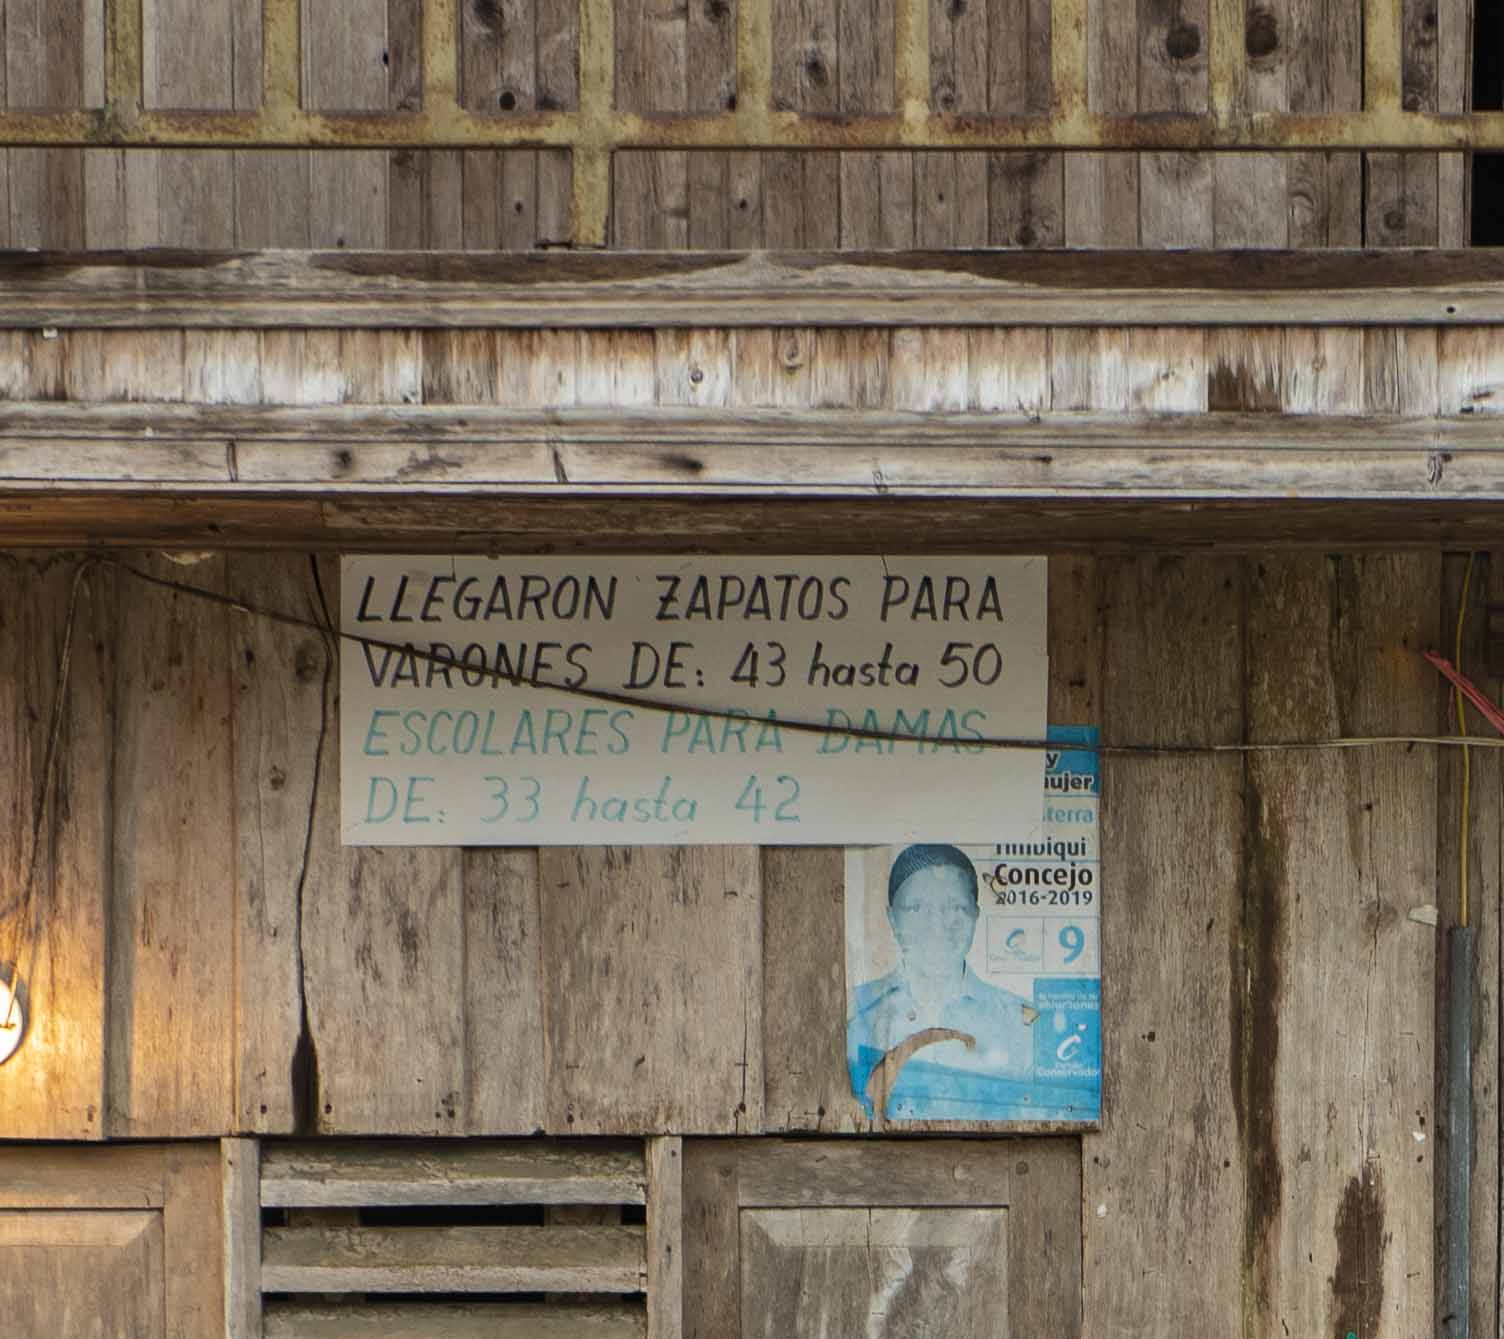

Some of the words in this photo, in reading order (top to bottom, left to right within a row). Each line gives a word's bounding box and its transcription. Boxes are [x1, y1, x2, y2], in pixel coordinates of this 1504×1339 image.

[356, 574, 618, 624] LLEGARON
[654, 574, 852, 623] ZAPATOS
[877, 574, 1004, 624] PARA
[360, 640, 593, 690] VARONES
[622, 641, 706, 689] DE:
[729, 641, 786, 688] 43
[807, 642, 921, 688] hasta
[937, 641, 1003, 688] 50
[362, 708, 631, 758] ESCOLARES
[661, 708, 785, 755] PARA
[815, 707, 989, 756] DAMAS
[362, 775, 447, 825] DE:
[480, 775, 541, 824] 33
[570, 776, 697, 824] hasta
[733, 774, 802, 824] 42
[1044, 775, 1093, 793] ujer
[1042, 806, 1094, 825] terra
[995, 862, 1094, 892] Concejo
[1057, 923, 1086, 965] 9
